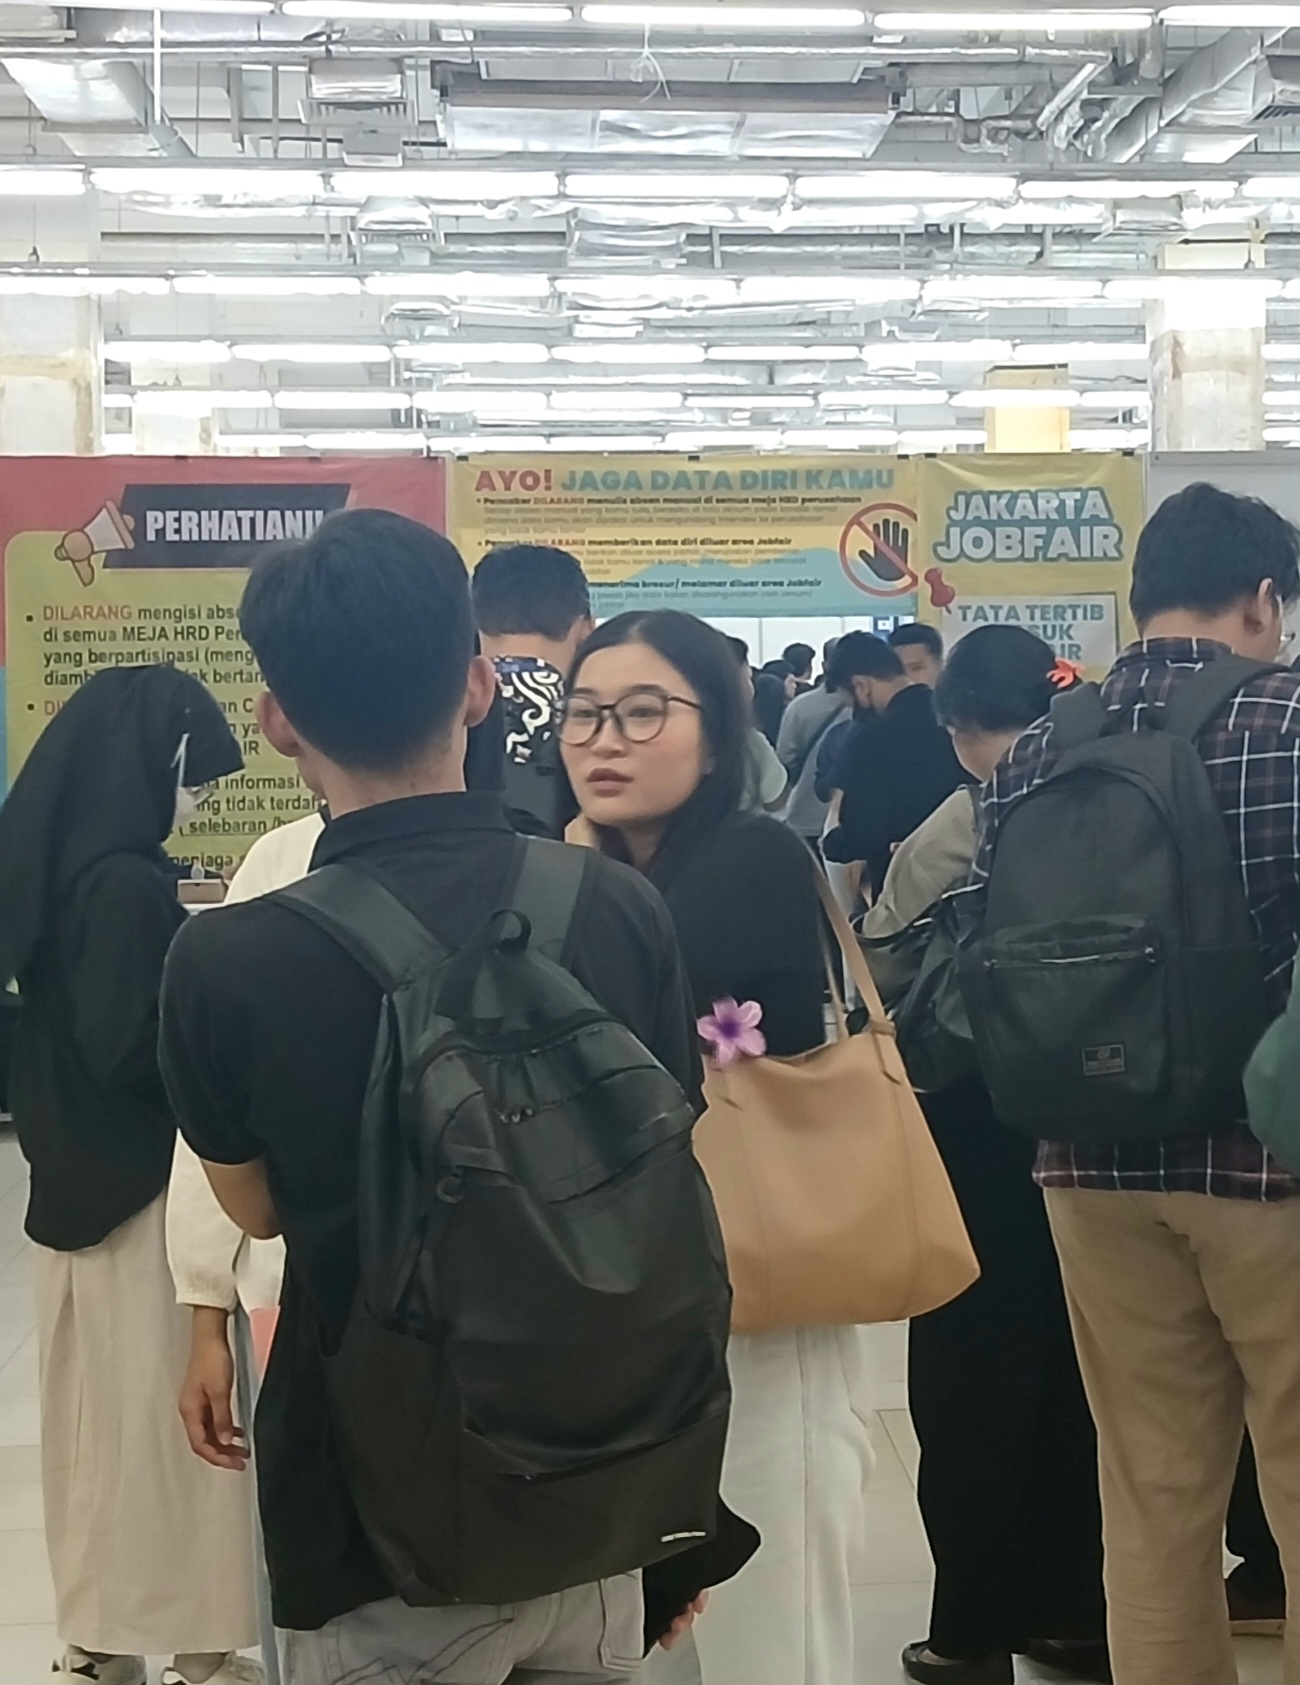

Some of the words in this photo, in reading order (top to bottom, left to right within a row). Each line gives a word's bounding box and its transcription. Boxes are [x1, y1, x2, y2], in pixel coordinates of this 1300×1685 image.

[475, 469, 552, 491] AYO!
[561, 470, 643, 491] JAGA
[651, 469, 733, 491] DATA
[740, 469, 798, 490] DIRI
[805, 468, 894, 490] KAMU
[533, 497, 585, 505] DILARANG
[948, 489, 1110, 521] JAKARTA
[588, 537, 653, 546] memberikan
[655, 538, 679, 546] data
[936, 526, 1121, 560] JOBFAIR
[43, 605, 132, 620] DILARANG
[138, 604, 201, 624] mengisi
[957, 605, 1021, 622] TATA
[1025, 604, 1105, 622] TERTIB
[43, 627, 58, 642] di
[63, 630, 117, 642] semua
[122, 626, 169, 641] MEJA
[174, 626, 209, 641] HRD
[43, 652, 83, 667] yang
[89, 648, 199, 667] berpartisipasi
[225, 774, 300, 790] informasi
[226, 795, 265, 811] tidak
[189, 818, 267, 834] selebaran
